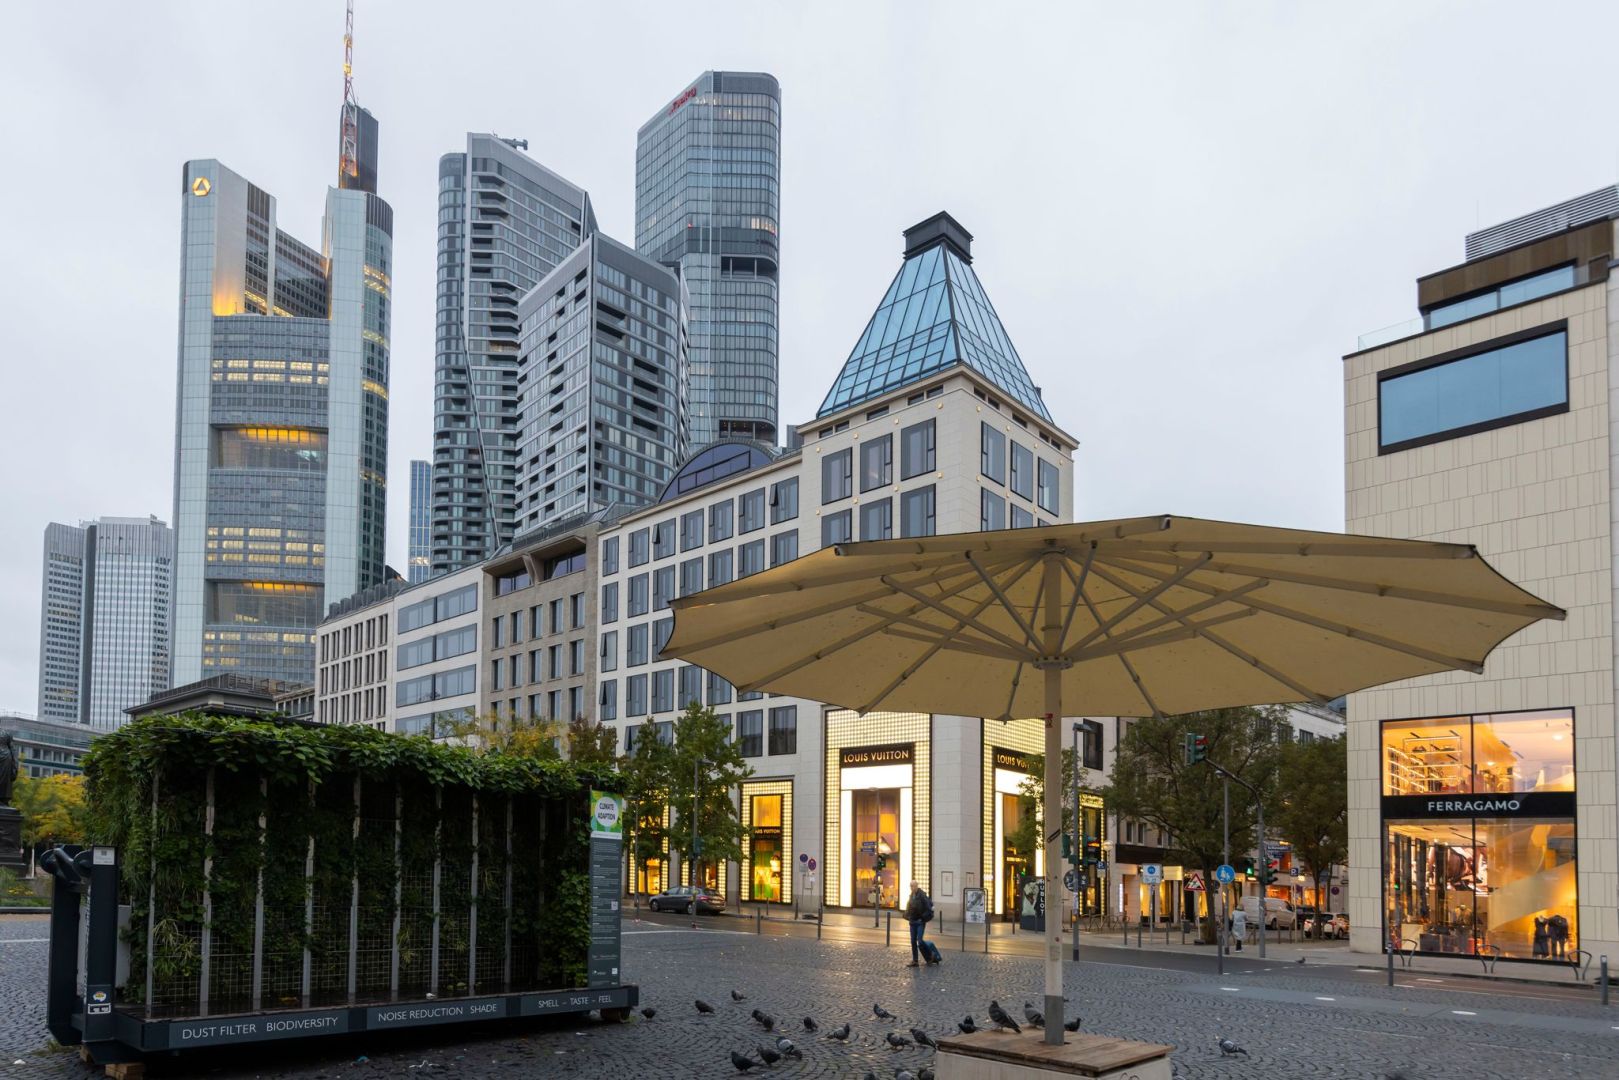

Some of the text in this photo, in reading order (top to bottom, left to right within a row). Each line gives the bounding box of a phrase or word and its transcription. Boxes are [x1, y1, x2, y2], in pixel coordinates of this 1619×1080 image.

[843, 750, 909, 763] LOUIS VUITTON
[997, 754, 1015, 766] LOUIS
[599, 802, 614, 811] CLIMATE
[1427, 799, 1520, 812] FERRAGAMO
[538, 999, 560, 1009] SMELL
[570, 996, 589, 1006] TASTE
[598, 995, 612, 1004] FEEL
[378, 1003, 497, 1022] NOISE REDUCTION SHADE
[182, 1017, 339, 1040] DUST FILTER BIODIVERSITY
